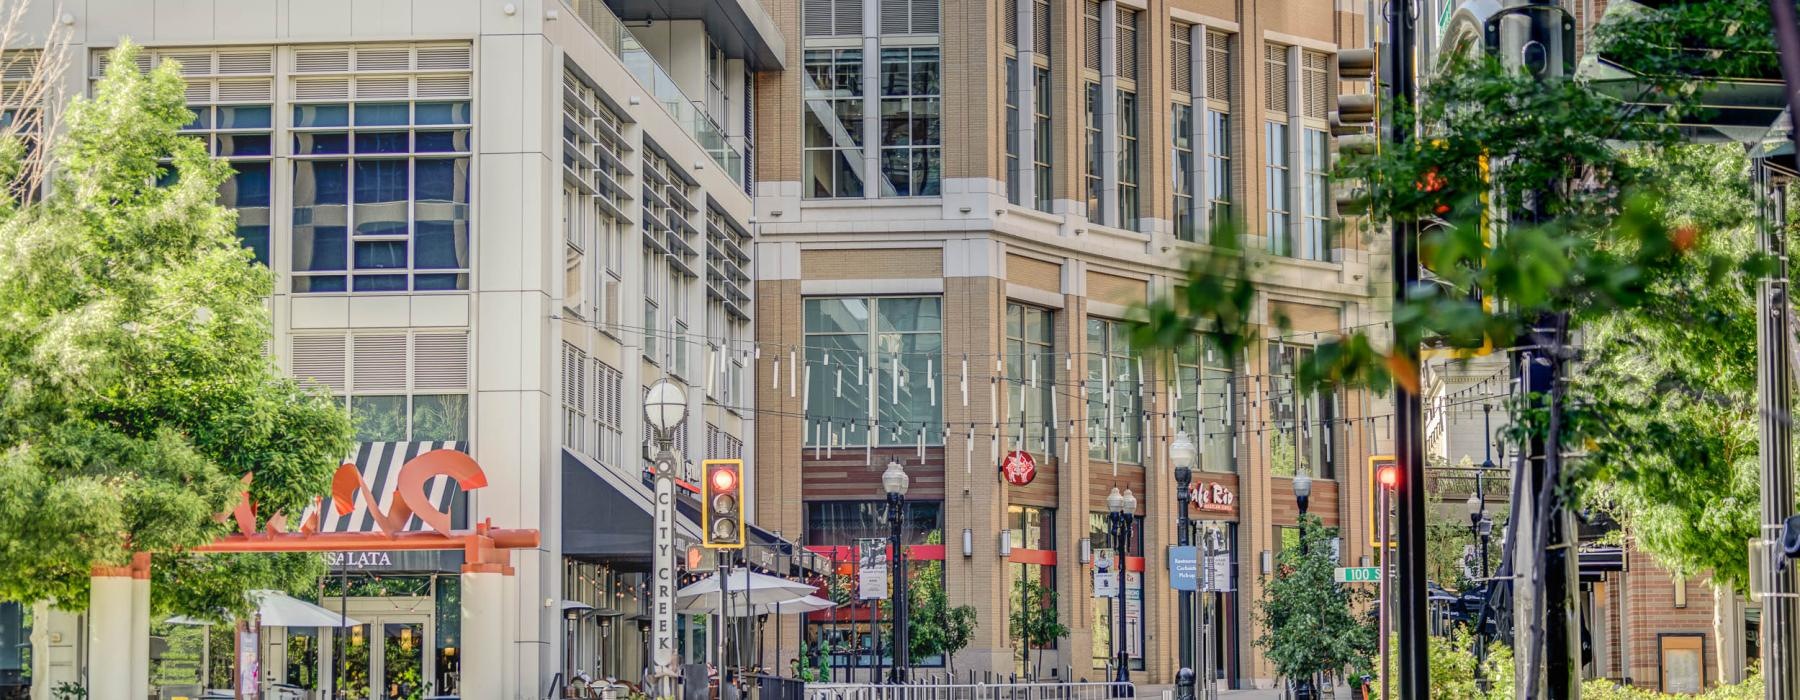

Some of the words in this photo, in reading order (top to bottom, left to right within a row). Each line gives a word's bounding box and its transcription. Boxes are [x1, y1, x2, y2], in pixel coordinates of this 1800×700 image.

[1188, 481, 1210, 508] afe
[1213, 482, 1233, 505] Rio
[658, 492, 669, 557] CITY
[1351, 568, 1370, 580] 100
[1374, 568, 1382, 580] S
[658, 567, 670, 650] CREEK
